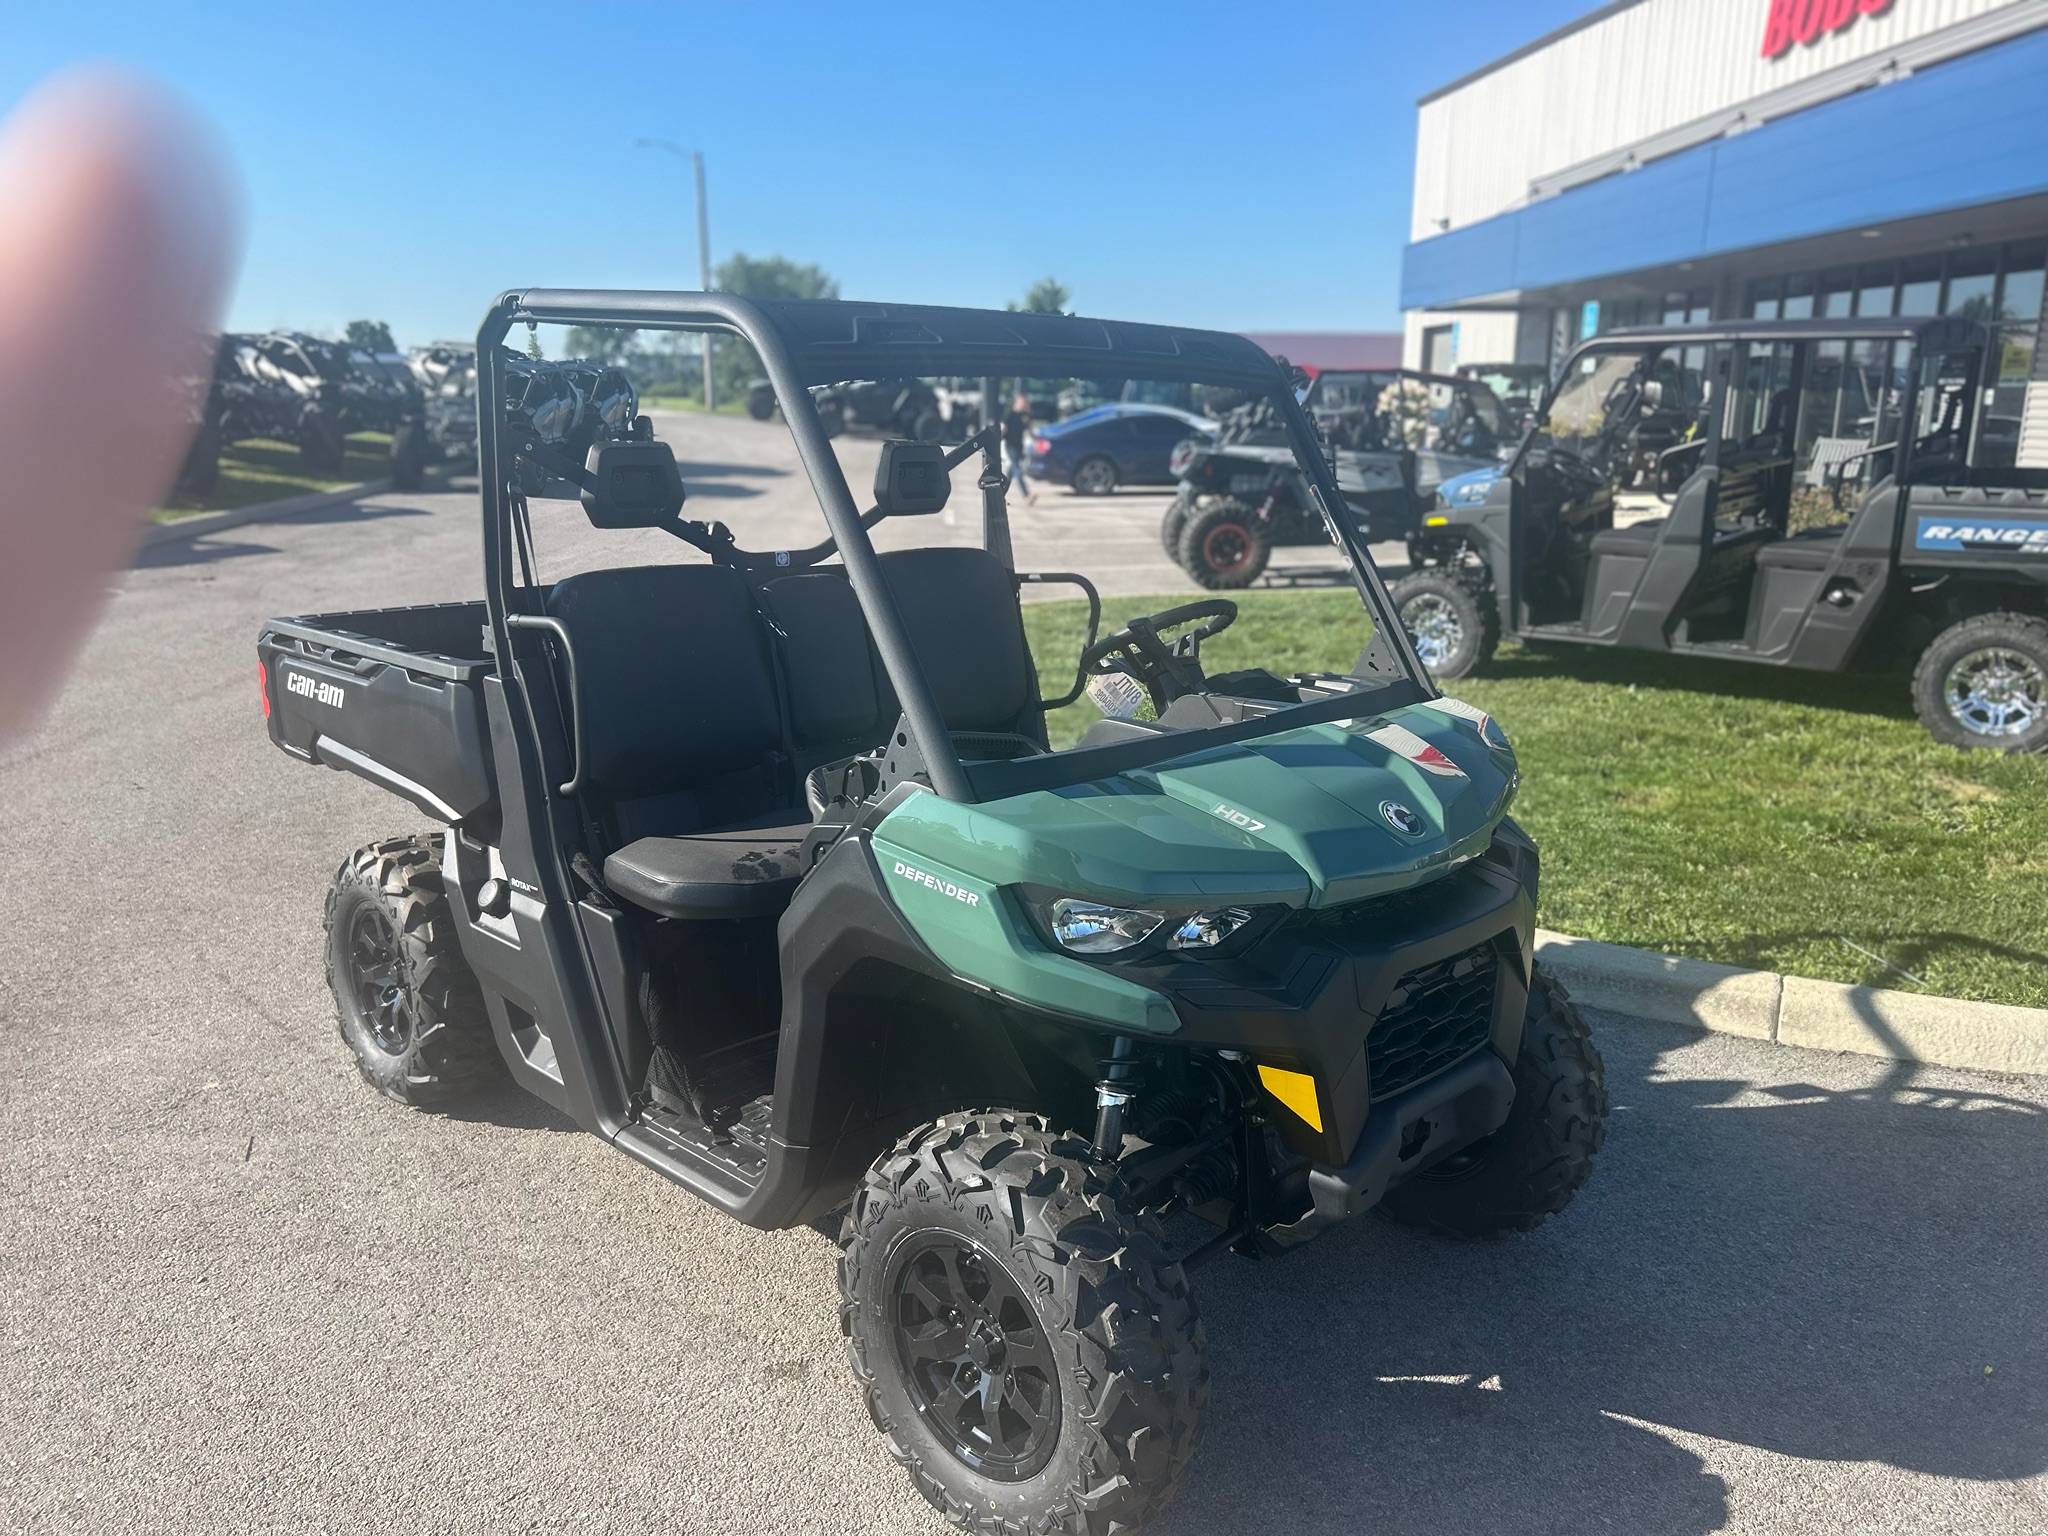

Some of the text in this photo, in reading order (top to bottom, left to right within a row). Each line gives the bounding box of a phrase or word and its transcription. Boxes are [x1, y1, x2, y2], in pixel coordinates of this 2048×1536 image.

[287, 671, 345, 709] can-am
[1213, 803, 1266, 832] HD7
[511, 877, 532, 892] ROTAX
[893, 861, 979, 907] DEFENDER
